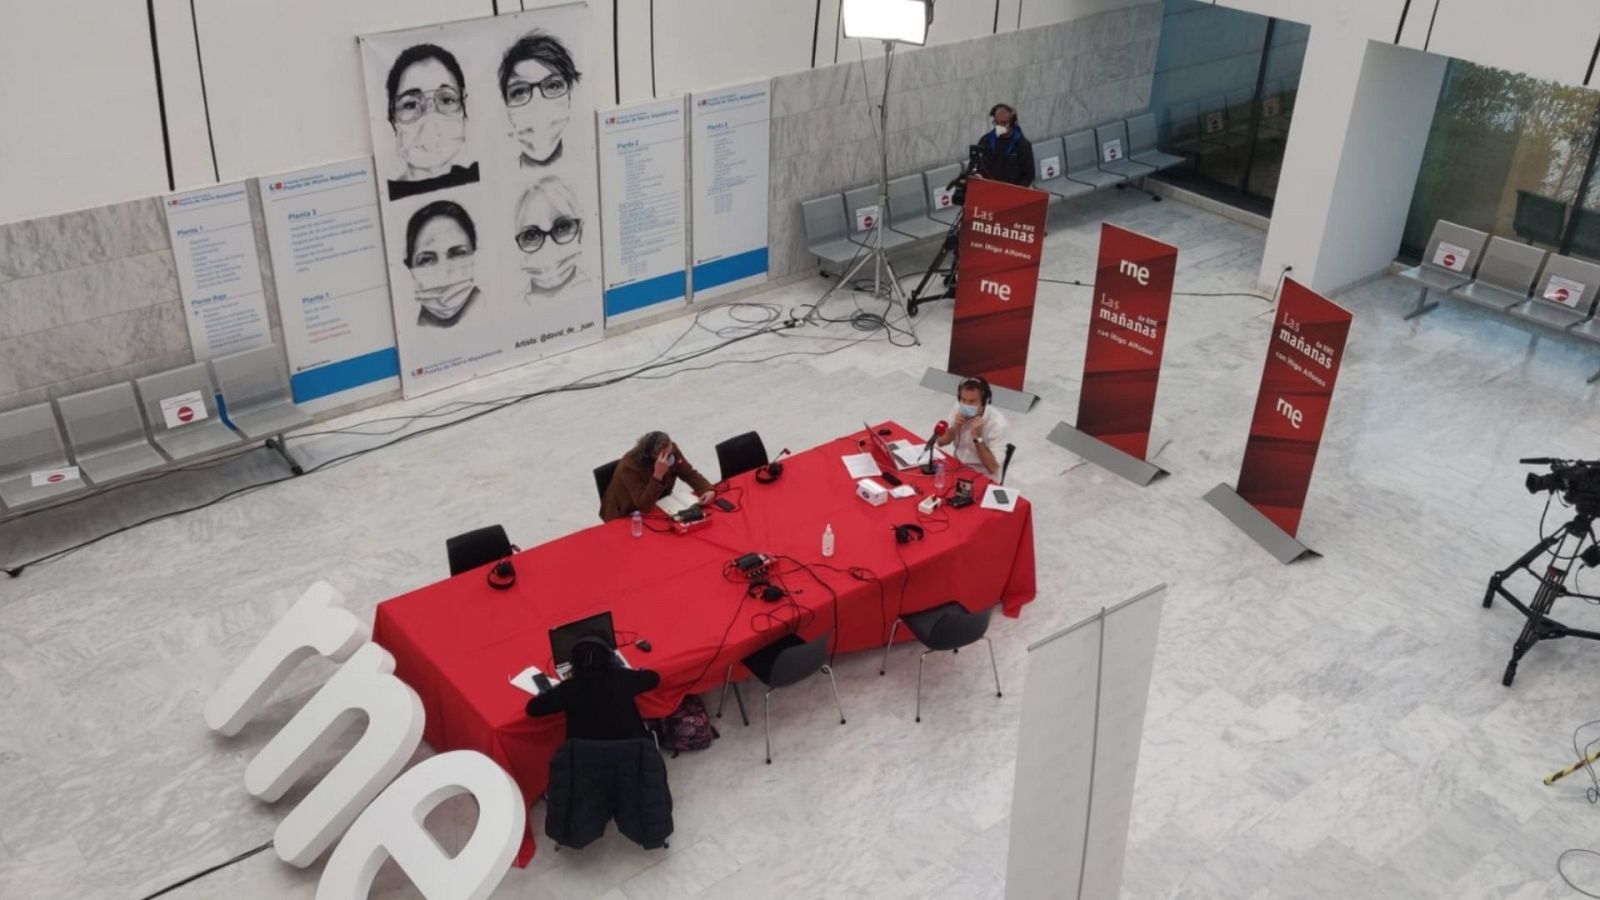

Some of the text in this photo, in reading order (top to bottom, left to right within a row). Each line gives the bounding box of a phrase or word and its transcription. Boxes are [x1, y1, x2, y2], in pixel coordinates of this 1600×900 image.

[288, 210, 311, 220] Planta
[973, 206, 994, 222] Las
[971, 220, 1035, 244] mañanas
[1013, 221, 1021, 230] de
[970, 241, 983, 249] con
[1003, 248, 1032, 260] Alfonso
[1119, 259, 1150, 286] rne
[980, 279, 1012, 301] rne
[1101, 292, 1120, 310] Las
[1099, 307, 1158, 340] mañanas
[1283, 312, 1301, 333] Las
[515, 337, 538, 349] Artista:
[1097, 328, 1110, 338] con
[1275, 351, 1287, 362] con
[1279, 328, 1333, 370] mañanas
[1276, 397, 1303, 429] rne
[204, 580, 527, 900] rne
